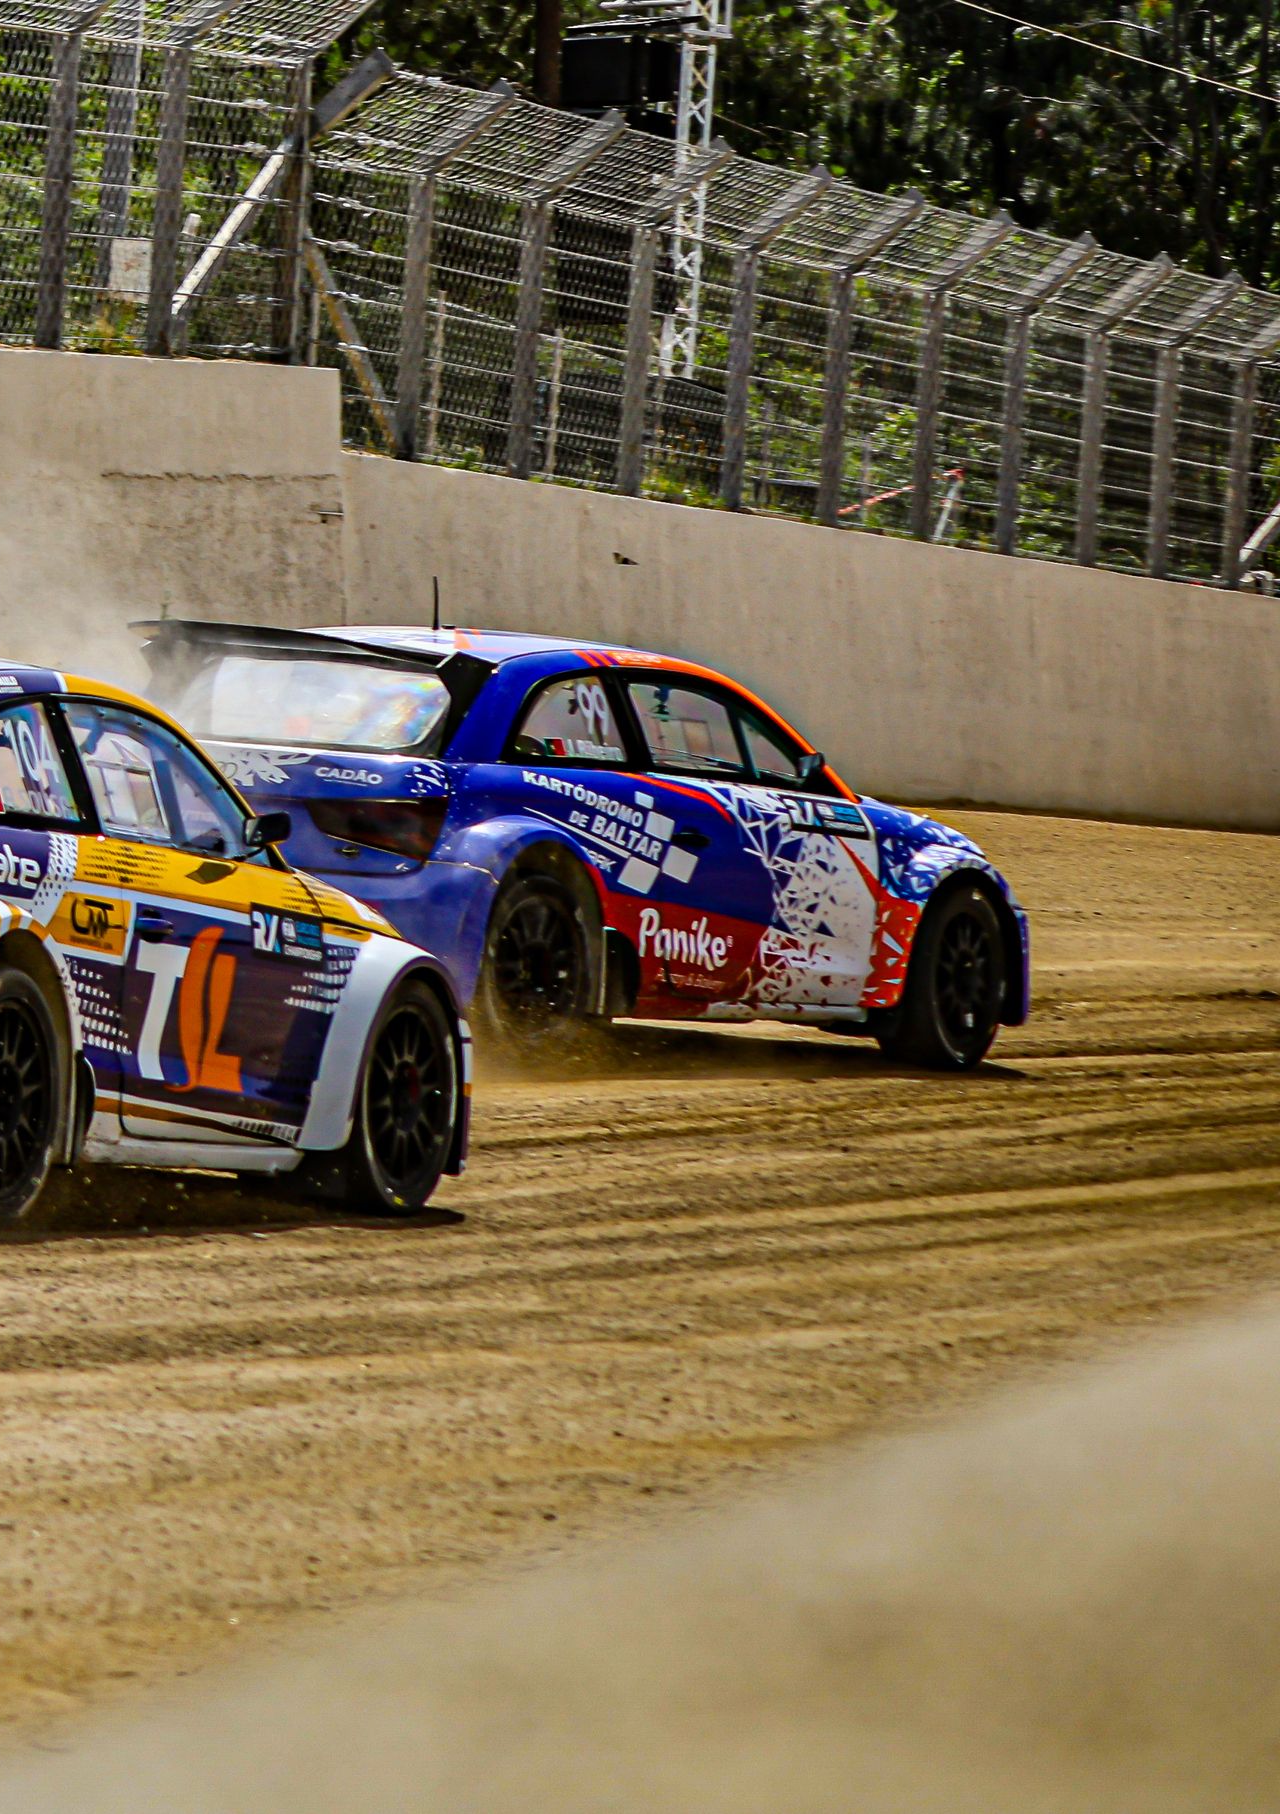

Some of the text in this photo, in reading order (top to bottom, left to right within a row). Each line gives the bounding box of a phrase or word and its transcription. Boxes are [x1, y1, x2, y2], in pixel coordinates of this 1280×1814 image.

[575, 683, 610, 736] 99
[1, 719, 60, 784] 104
[314, 766, 383, 785] CADÃO
[521, 770, 644, 828] KARTÓDROMO
[568, 810, 590, 828] DE
[590, 814, 663, 862] BALTAR
